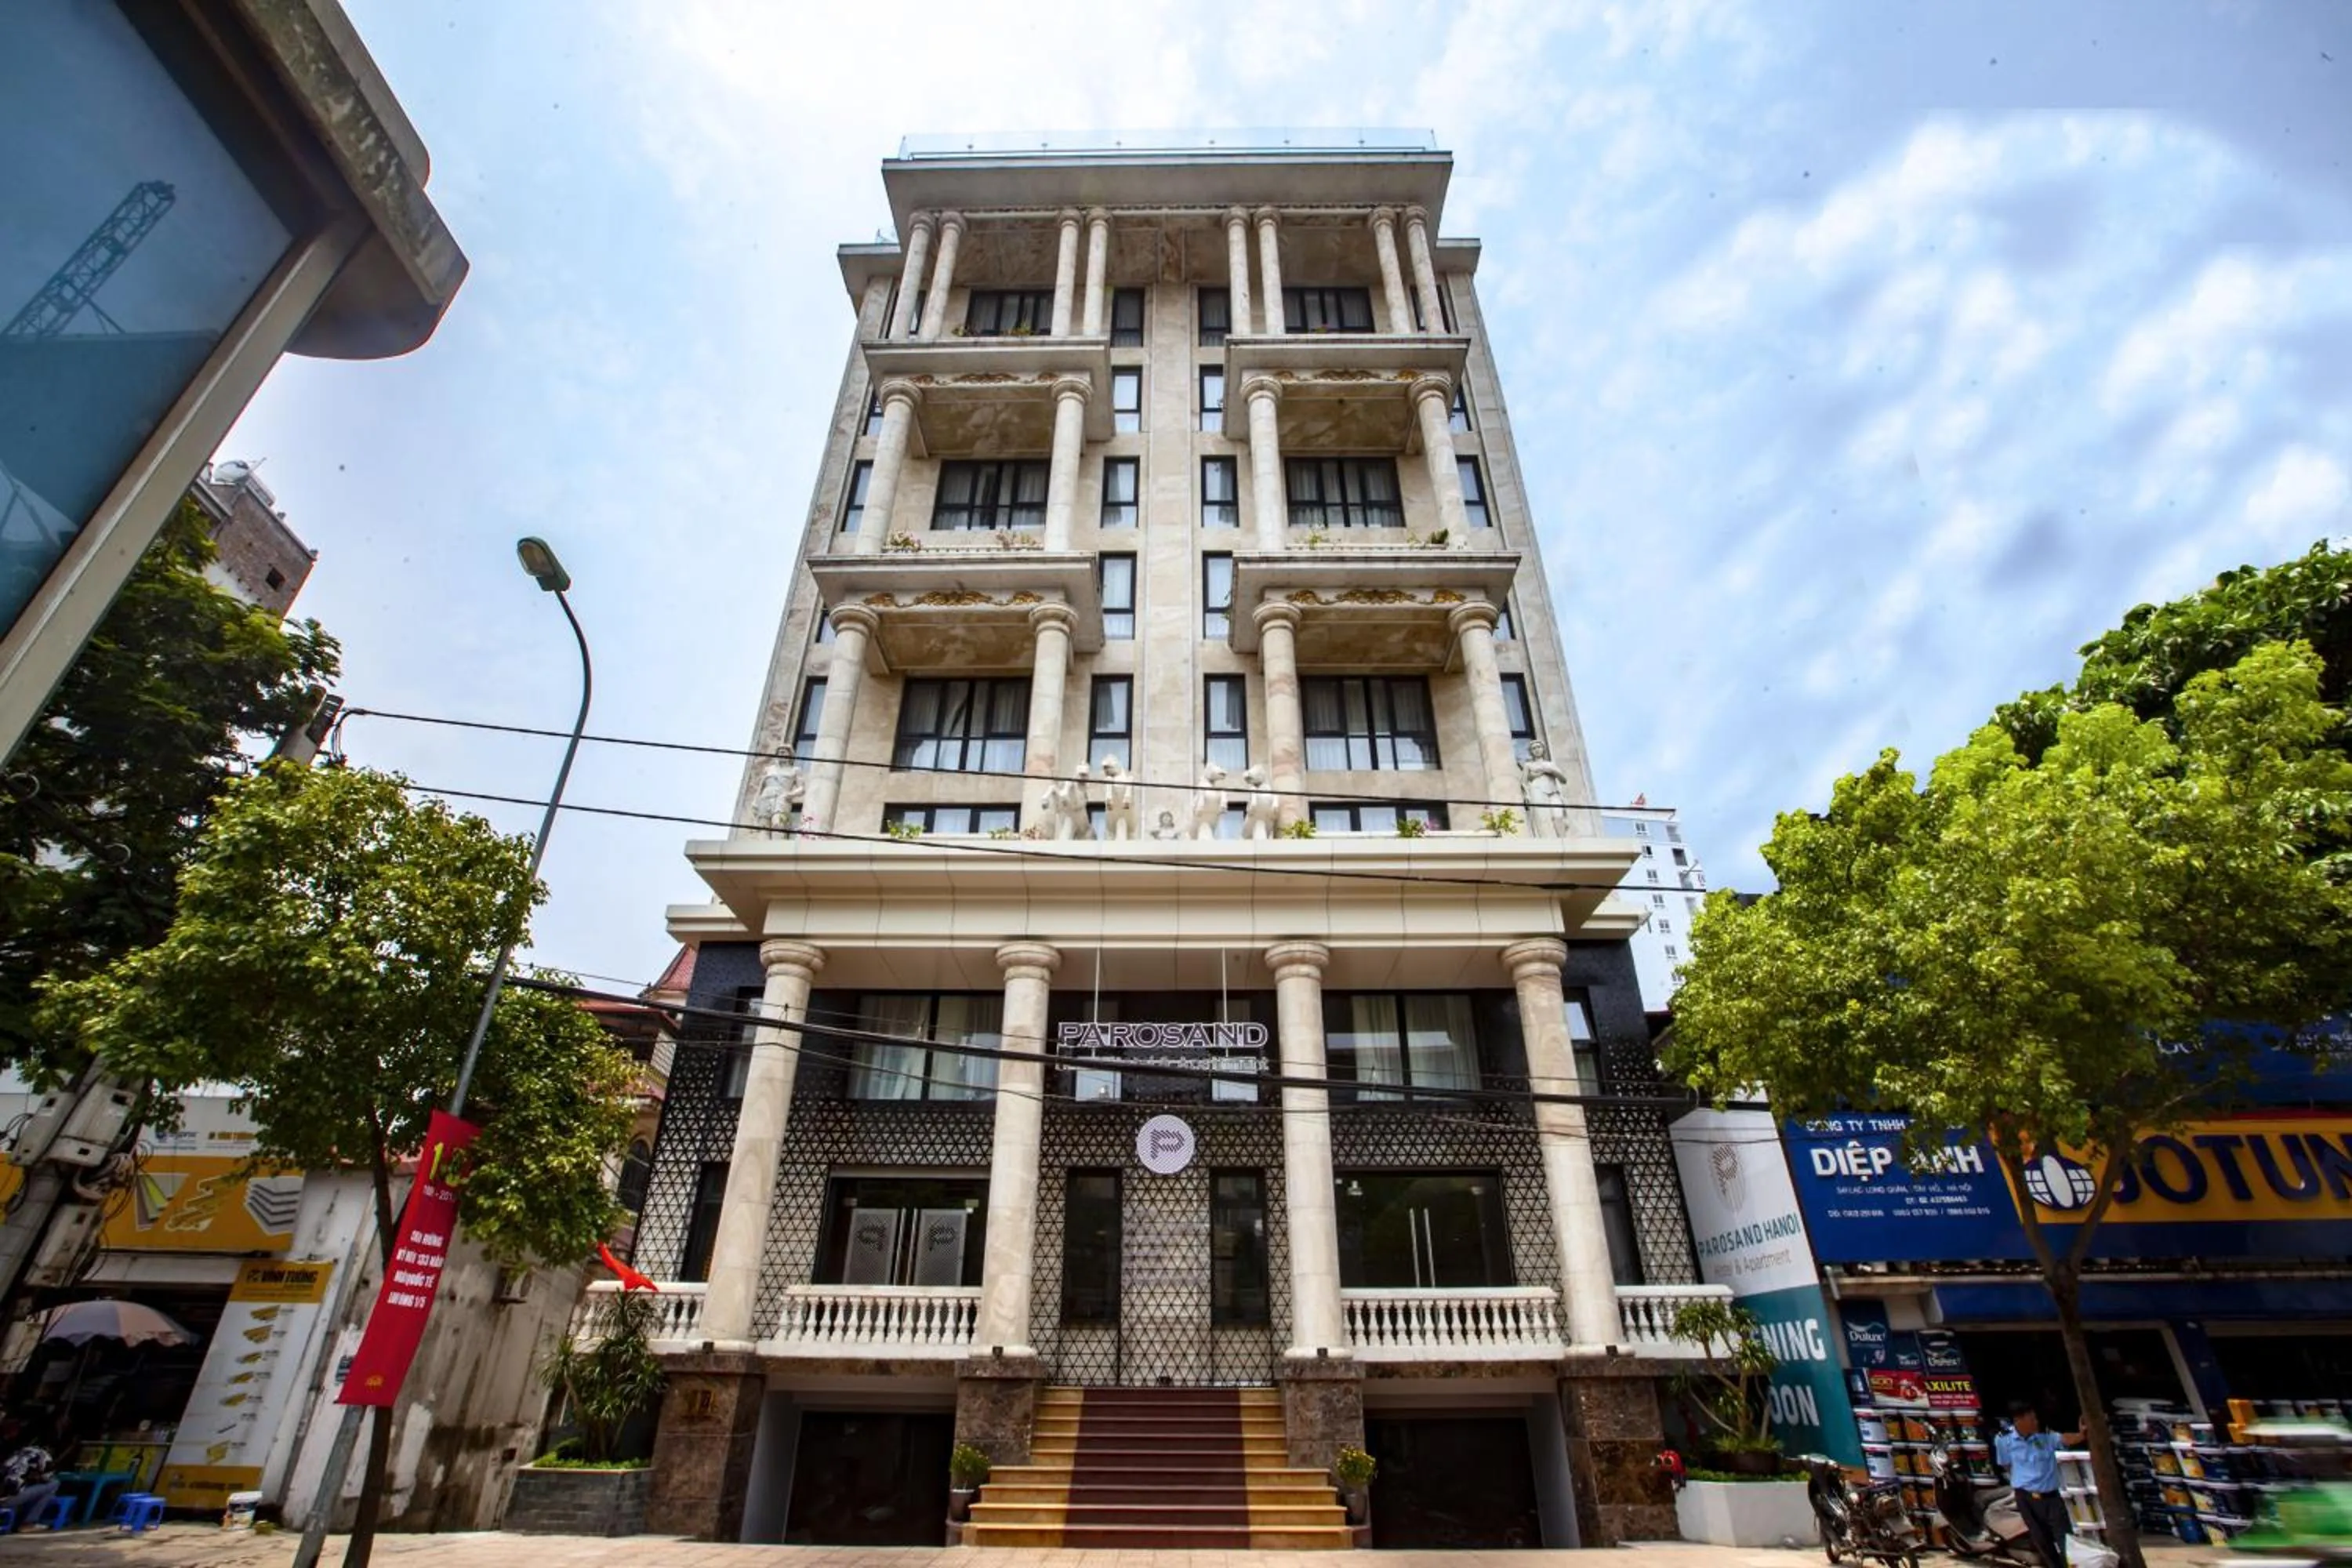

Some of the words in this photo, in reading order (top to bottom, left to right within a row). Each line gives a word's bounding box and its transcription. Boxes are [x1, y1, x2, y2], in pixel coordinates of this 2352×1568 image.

[1058, 1022, 1269, 1048] PAROSAND
[1846, 1120, 1864, 1131] TY
[1869, 1119, 1906, 1131] TNHH
[1810, 1140, 1893, 1181] DIỆP
[1698, 1224, 1763, 1258] PAROSAND
[1764, 1213, 1801, 1241] HANOI
[1751, 1319, 1827, 1361] NING
[1768, 1384, 1820, 1427] OON
